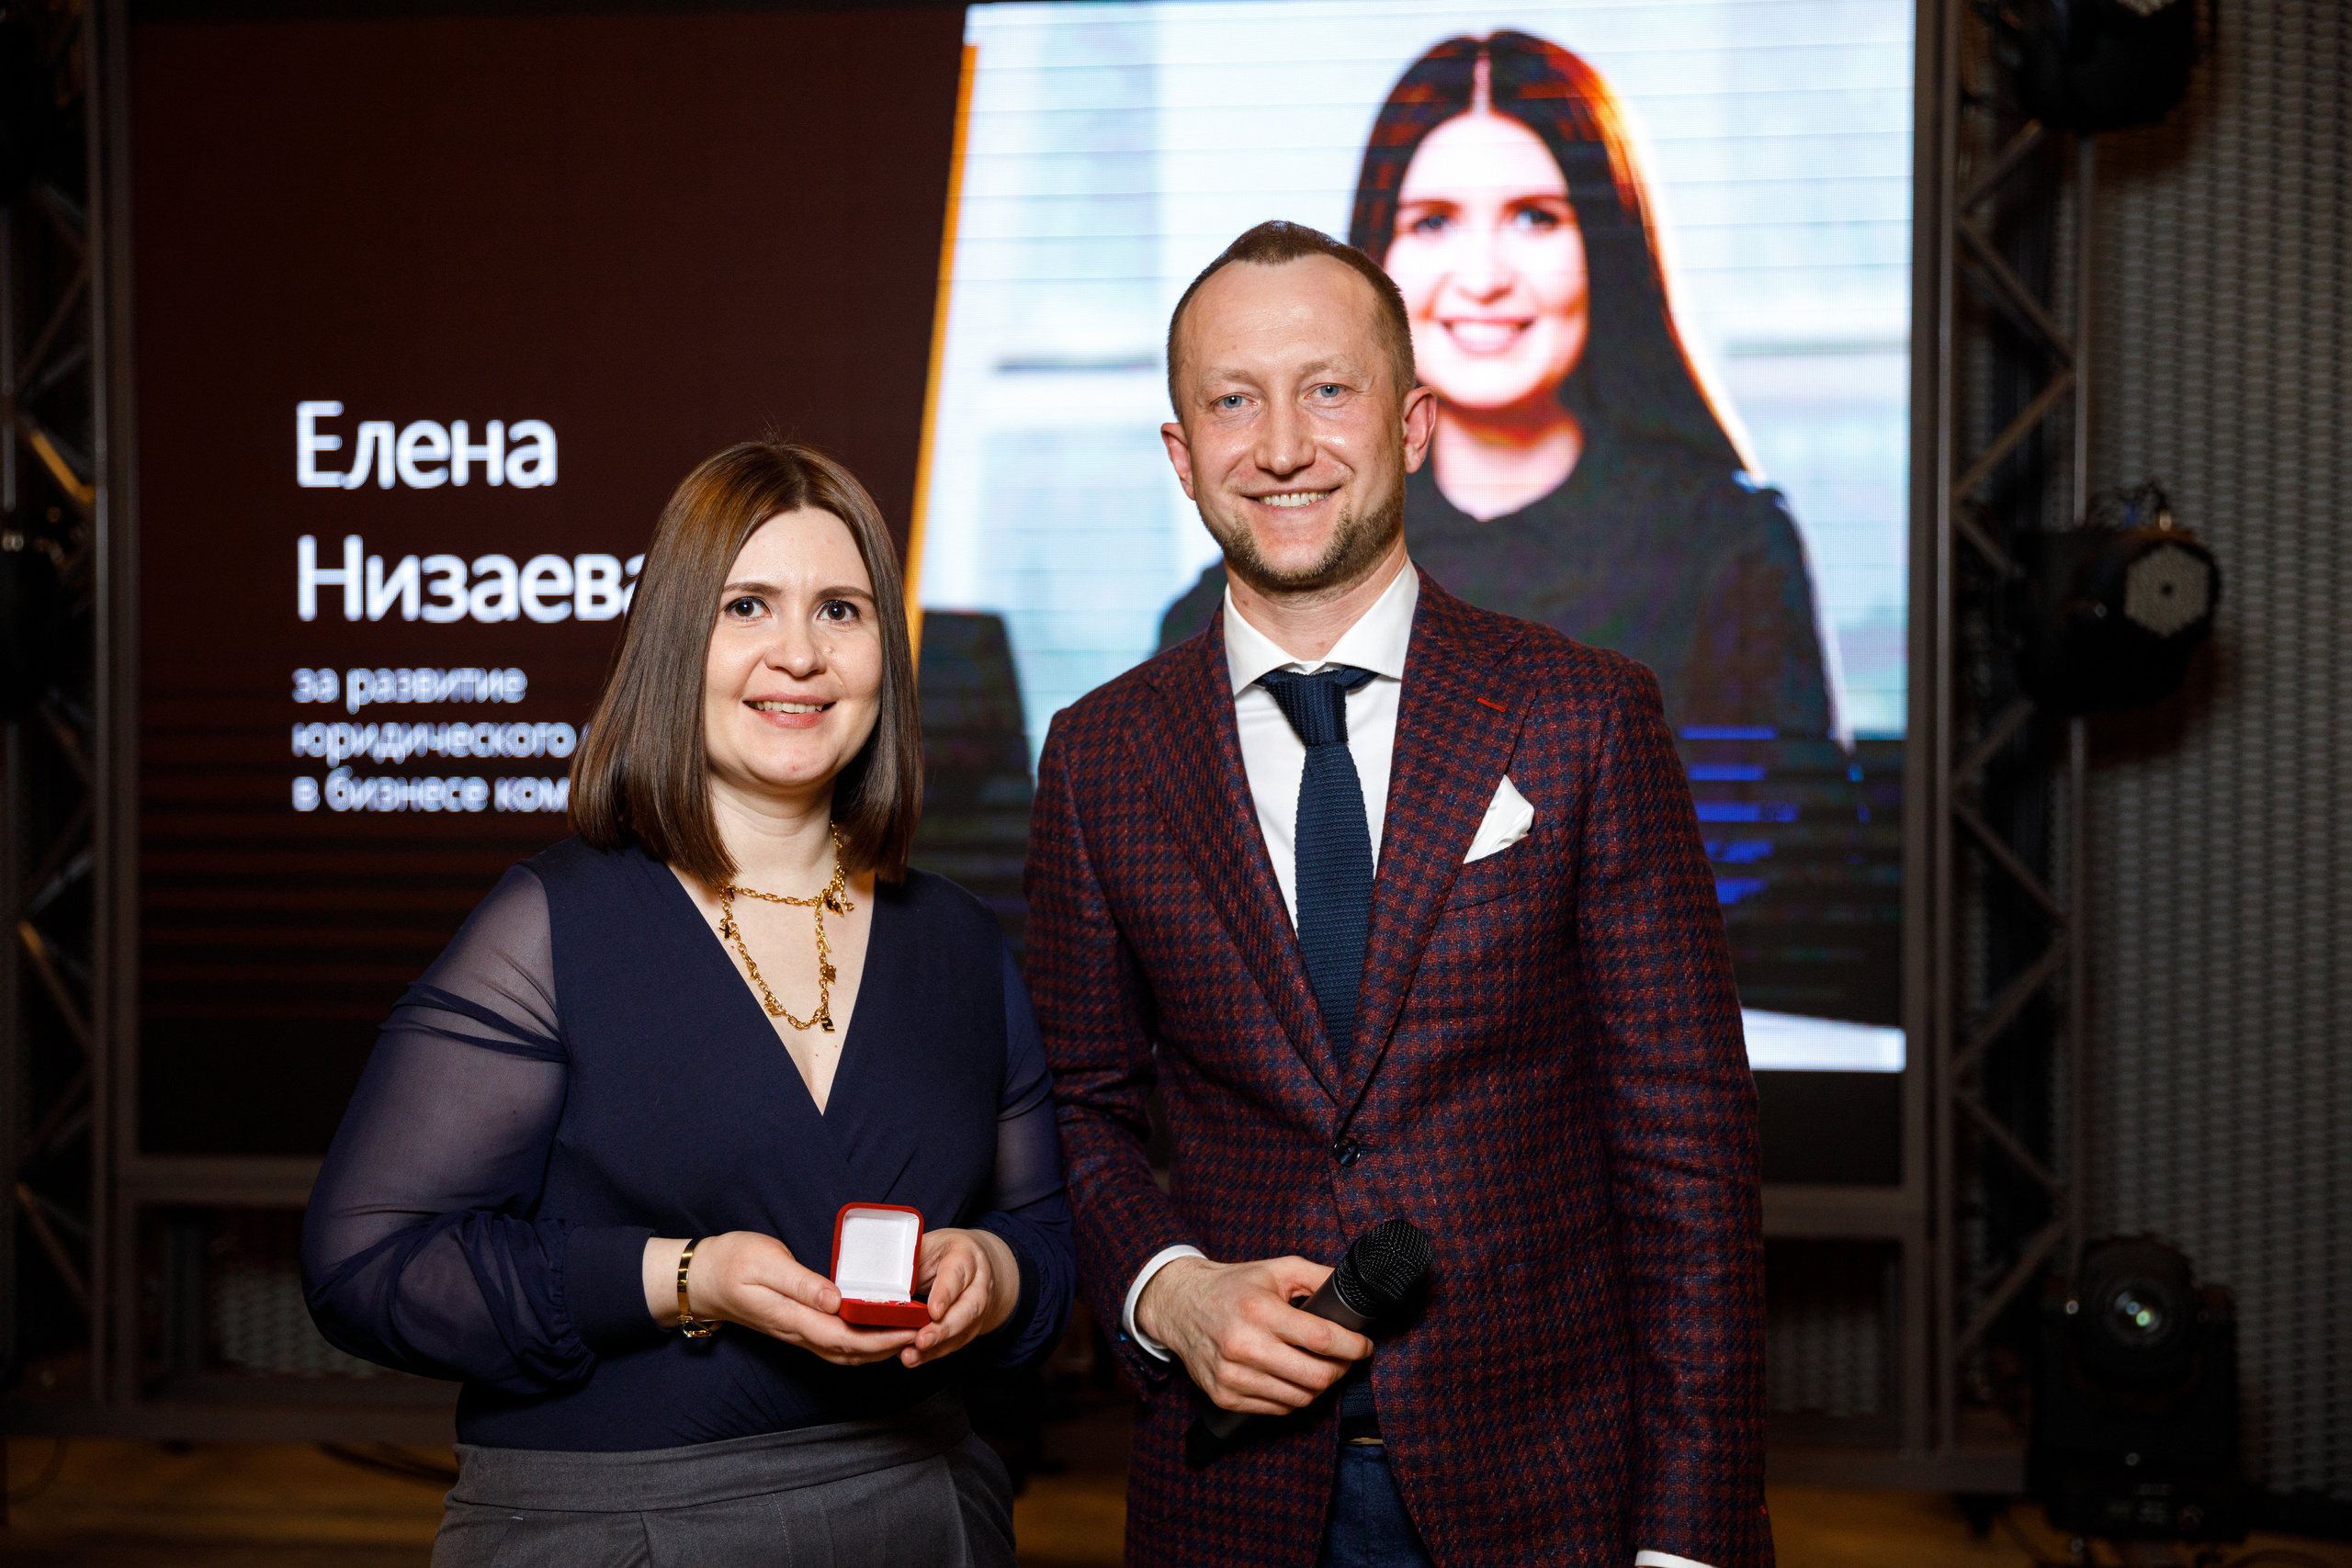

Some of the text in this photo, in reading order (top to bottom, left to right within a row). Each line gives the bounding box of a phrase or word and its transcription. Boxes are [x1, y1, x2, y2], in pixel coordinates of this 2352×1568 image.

[297, 400, 558, 489] Елена
[292, 668, 527, 714] за развитие
[292, 723, 576, 768] юридического
[292, 777, 320, 811] в
[325, 765, 490, 812] бизнесе
